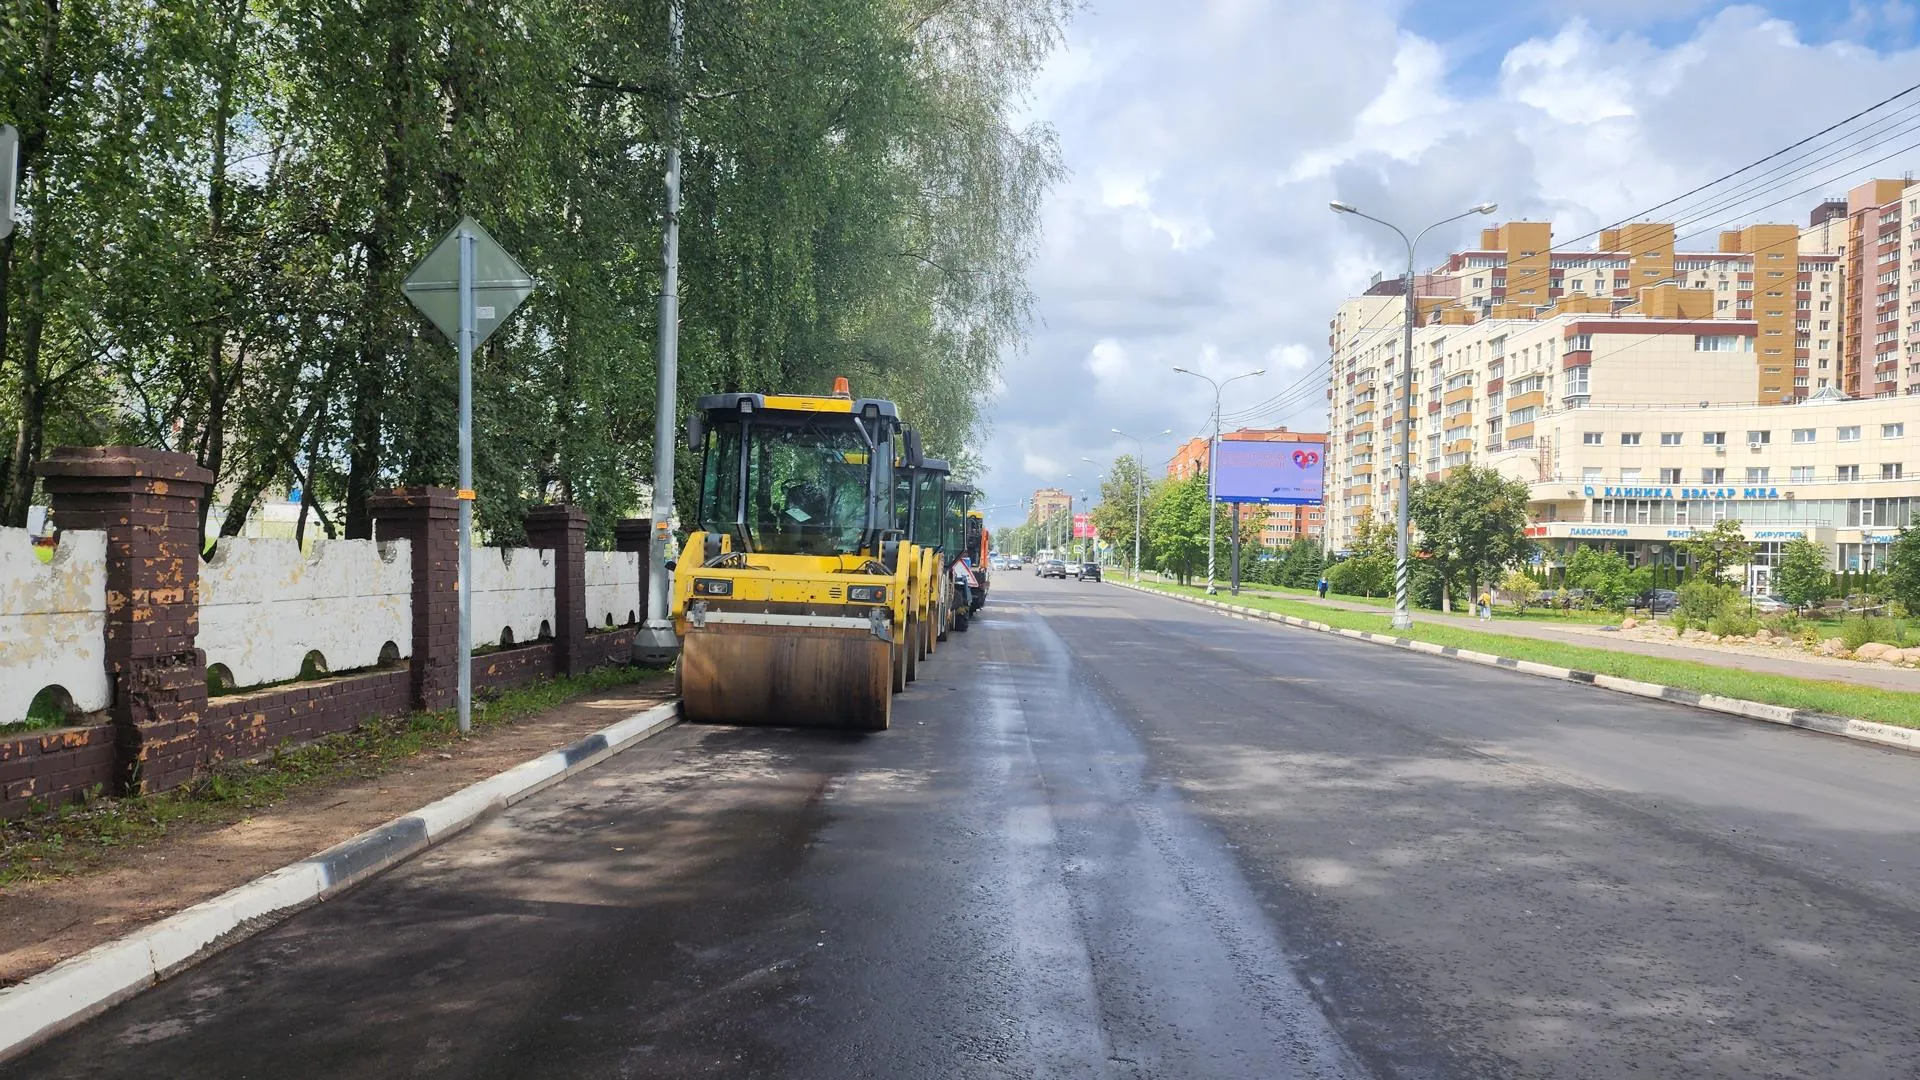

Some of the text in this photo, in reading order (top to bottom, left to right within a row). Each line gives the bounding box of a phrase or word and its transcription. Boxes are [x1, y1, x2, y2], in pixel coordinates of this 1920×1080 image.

[1604, 486, 1673, 499] КЛИНИКА
[1743, 488, 1779, 499] МЕД
[1570, 528, 1628, 537] ЛАБОРАТОРИЯ
